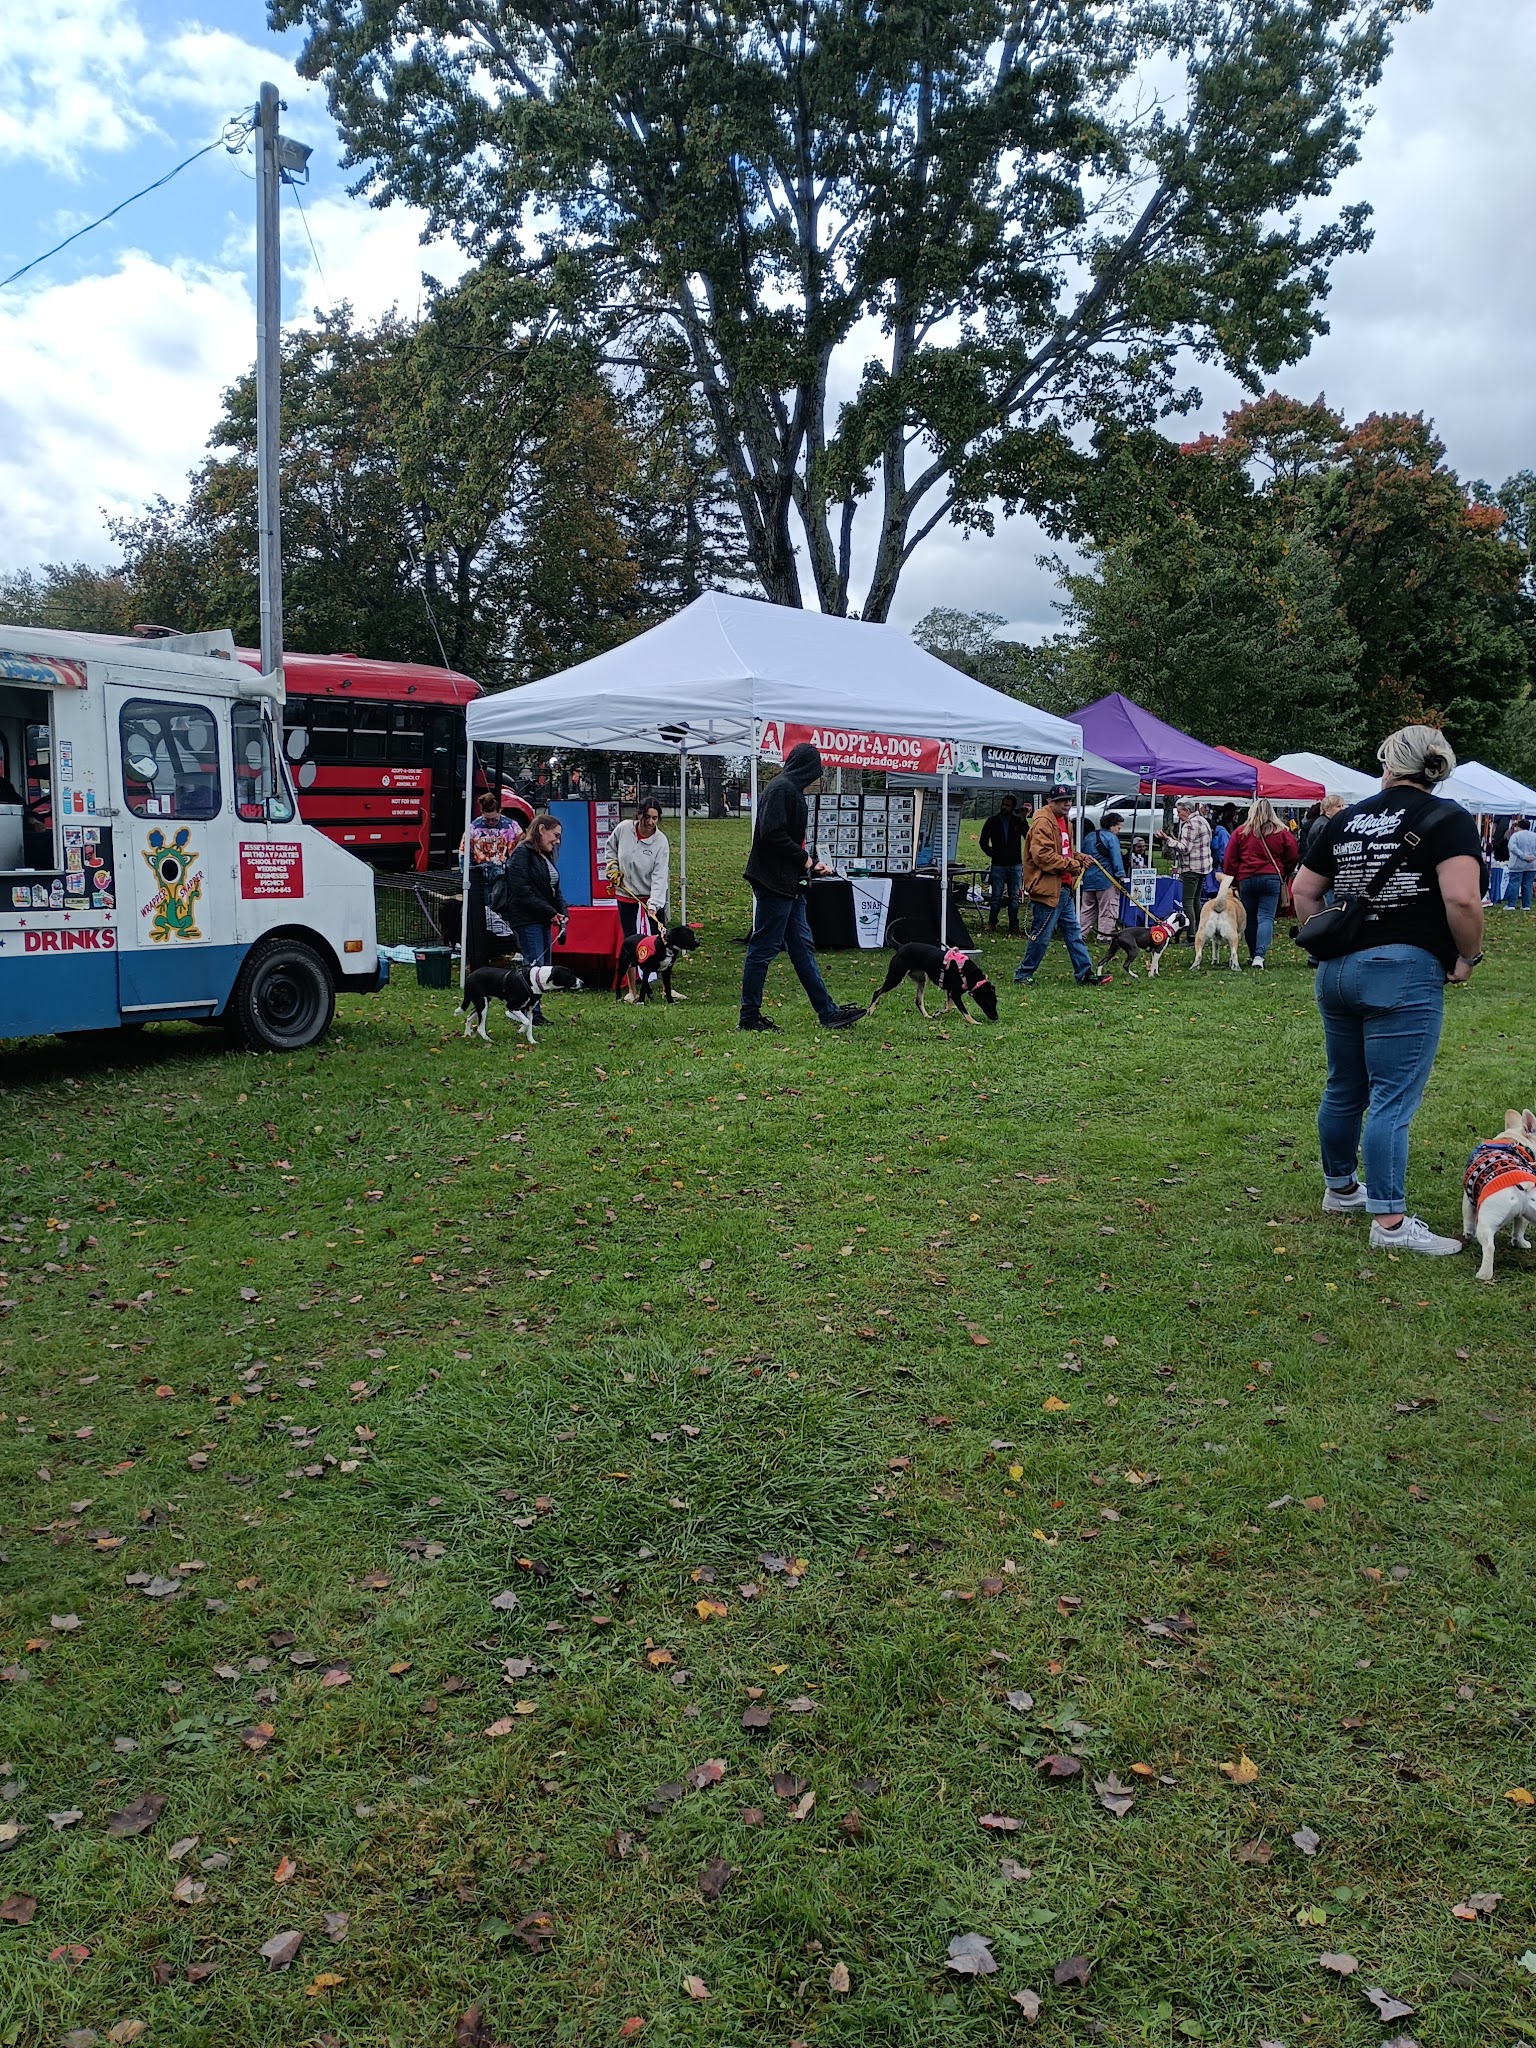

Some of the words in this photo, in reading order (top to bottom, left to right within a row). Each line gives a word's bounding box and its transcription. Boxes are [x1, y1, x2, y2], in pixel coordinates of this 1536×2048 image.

[809, 729, 922, 757] ADOPT-A-DOG
[820, 752, 920, 771] ww.adoptadog.org
[1015, 752, 1053, 767] NORTHEAST
[274, 851, 300, 859] PARTIES
[180, 871, 205, 898] SNAPPER
[140, 888, 168, 918] WRAPPER
[24, 929, 115, 952] DRINKS
